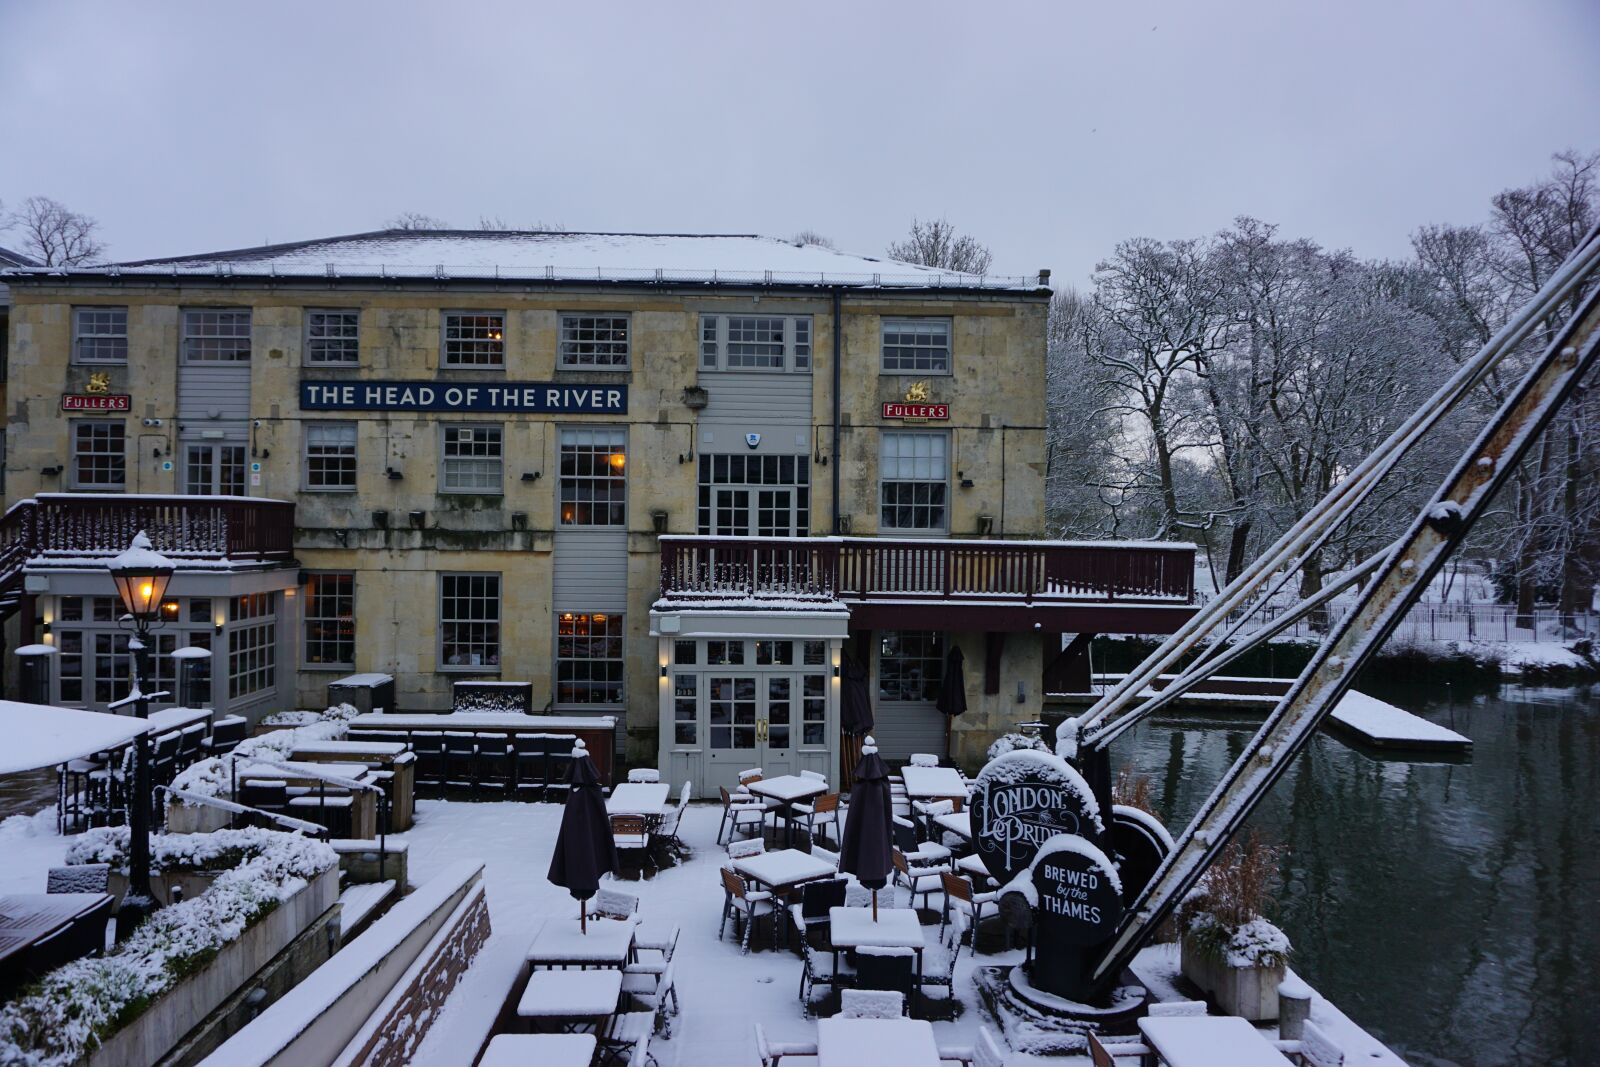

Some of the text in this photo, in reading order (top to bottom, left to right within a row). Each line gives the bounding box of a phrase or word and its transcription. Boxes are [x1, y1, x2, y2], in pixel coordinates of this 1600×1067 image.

[307, 386, 621, 408] THE HEAD OF THE RIVER
[887, 404, 945, 417] FULLER'S
[980, 783, 1067, 837] LONDON
[1044, 864, 1098, 890] BREWED
[1056, 882, 1088, 900] by the
[1043, 894, 1101, 924] THAMES
